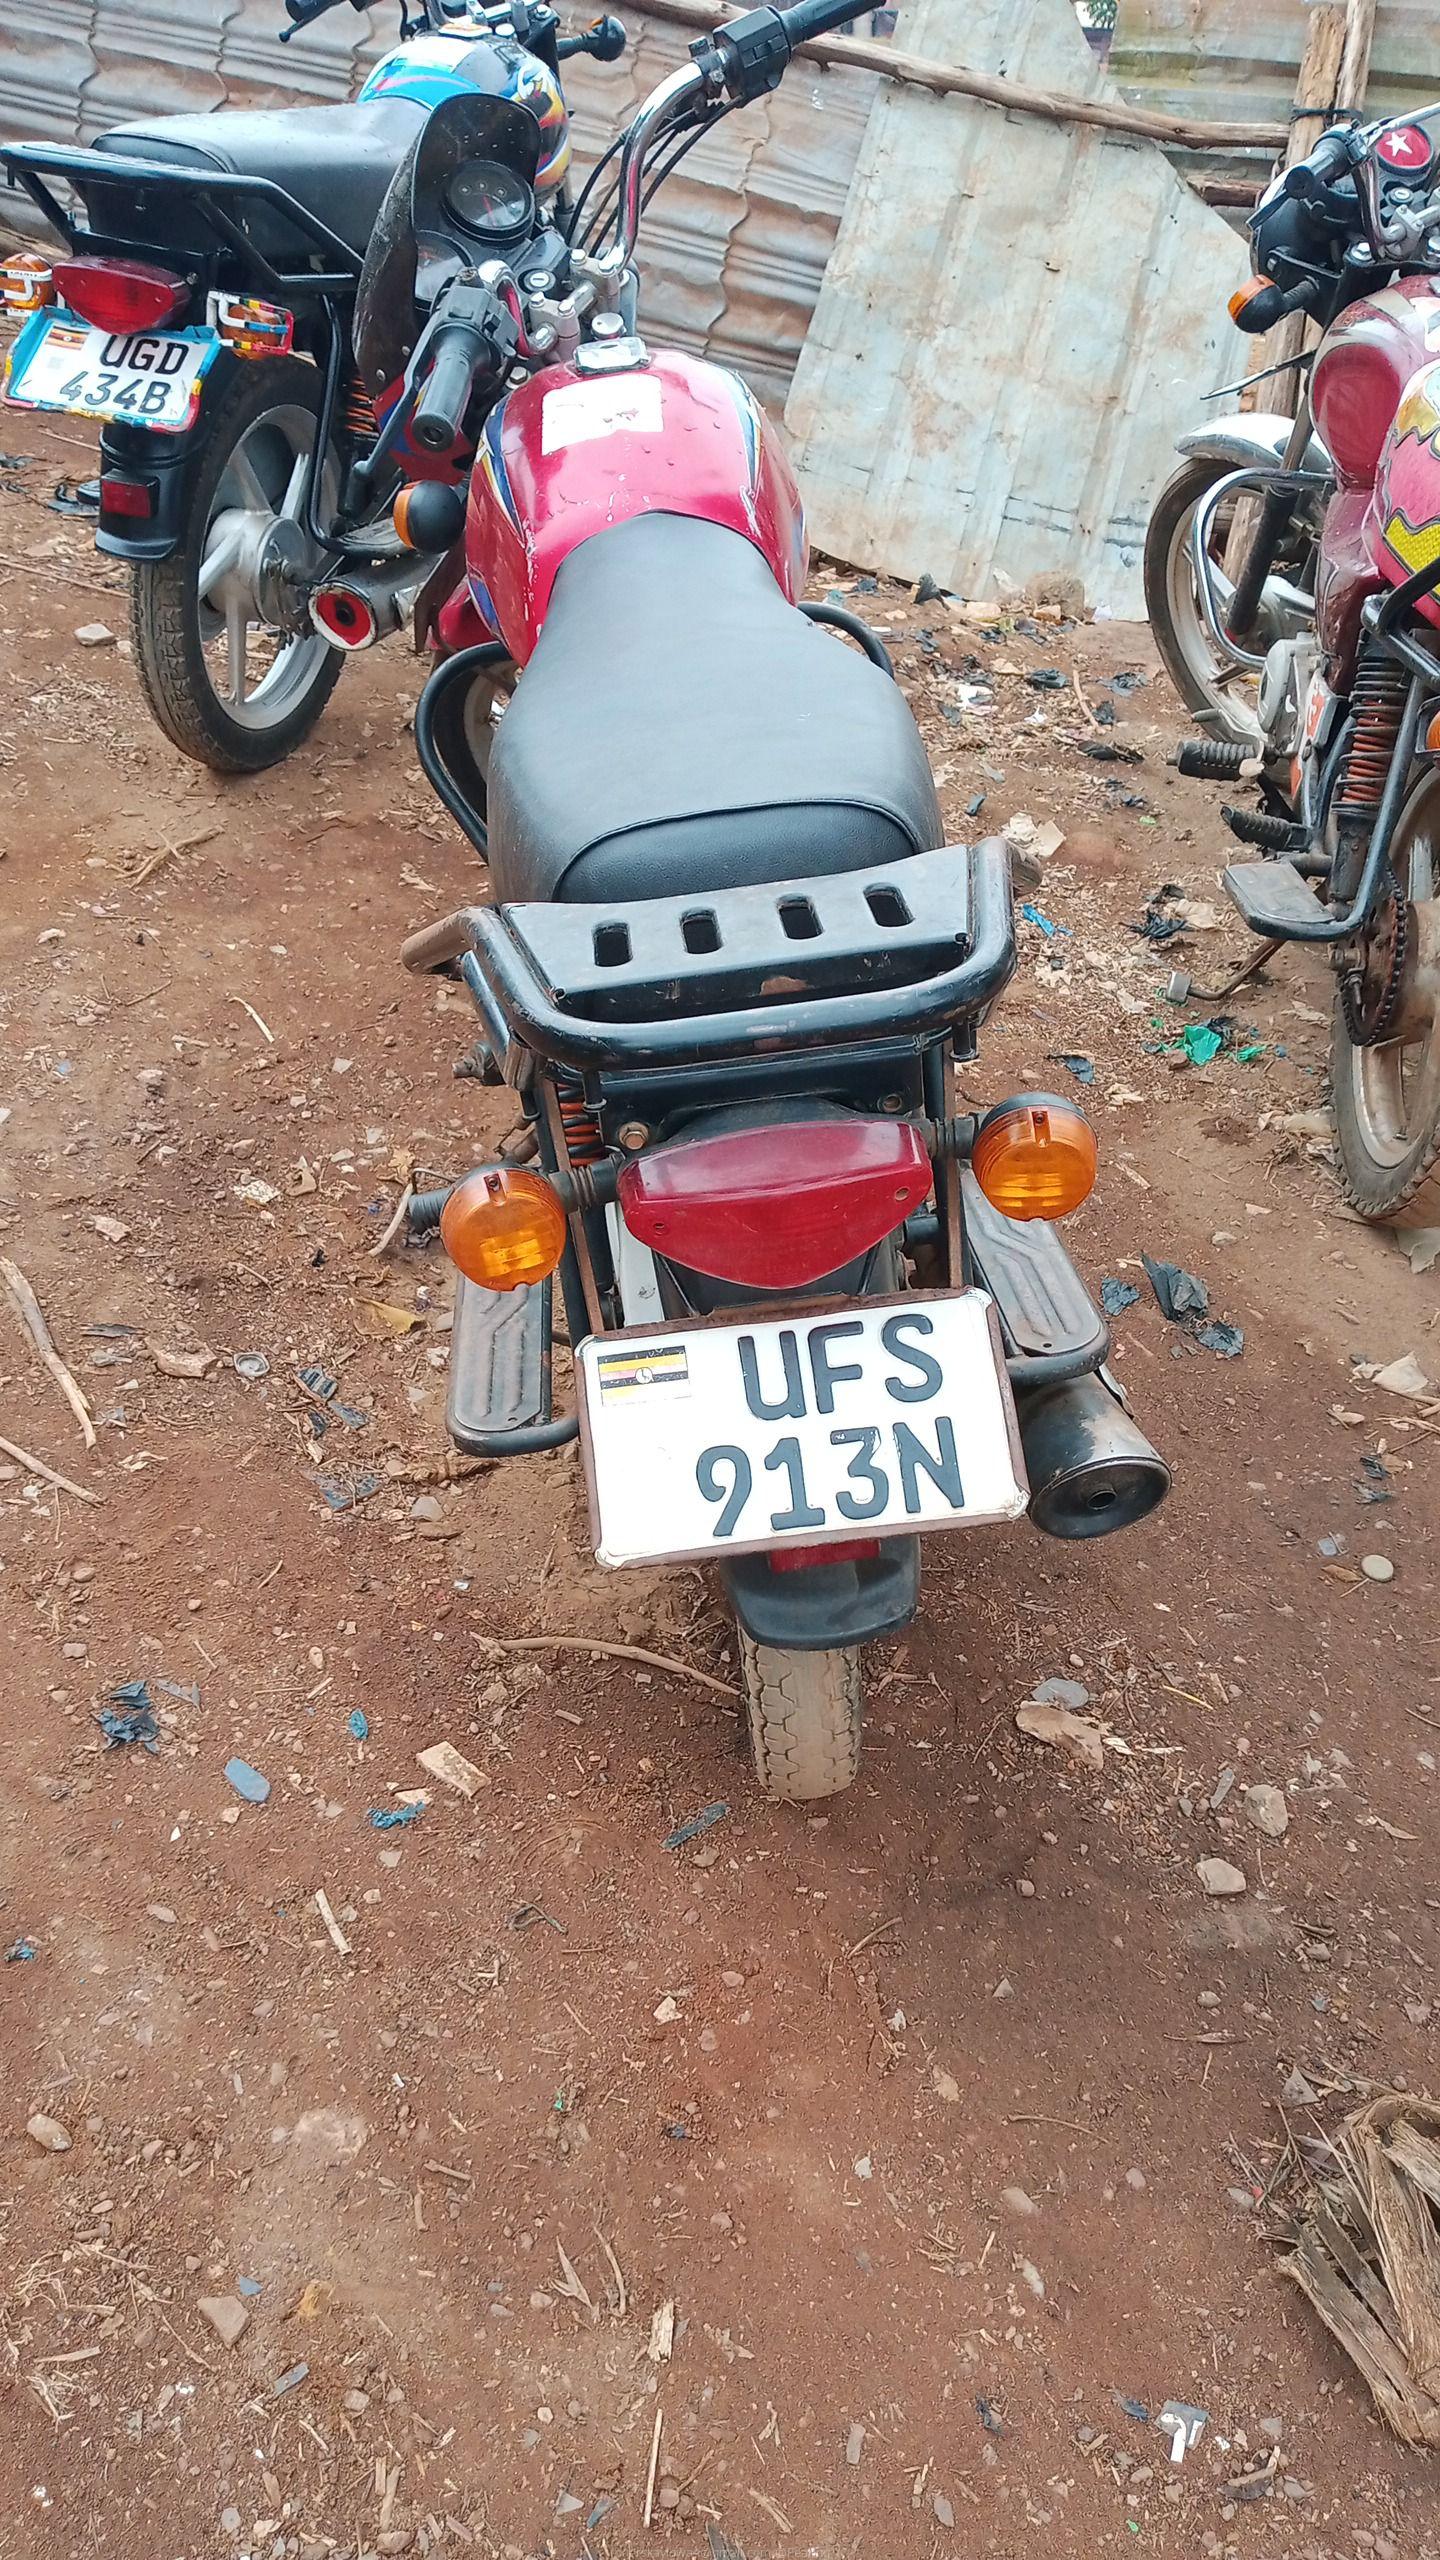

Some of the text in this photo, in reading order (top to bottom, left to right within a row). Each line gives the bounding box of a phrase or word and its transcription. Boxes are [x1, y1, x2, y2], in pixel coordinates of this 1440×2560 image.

[100, 334, 189, 375] UGD
[60, 371, 171, 414] 434B
[738, 1313, 943, 1421] UFS
[696, 1416, 964, 1537] 913N
